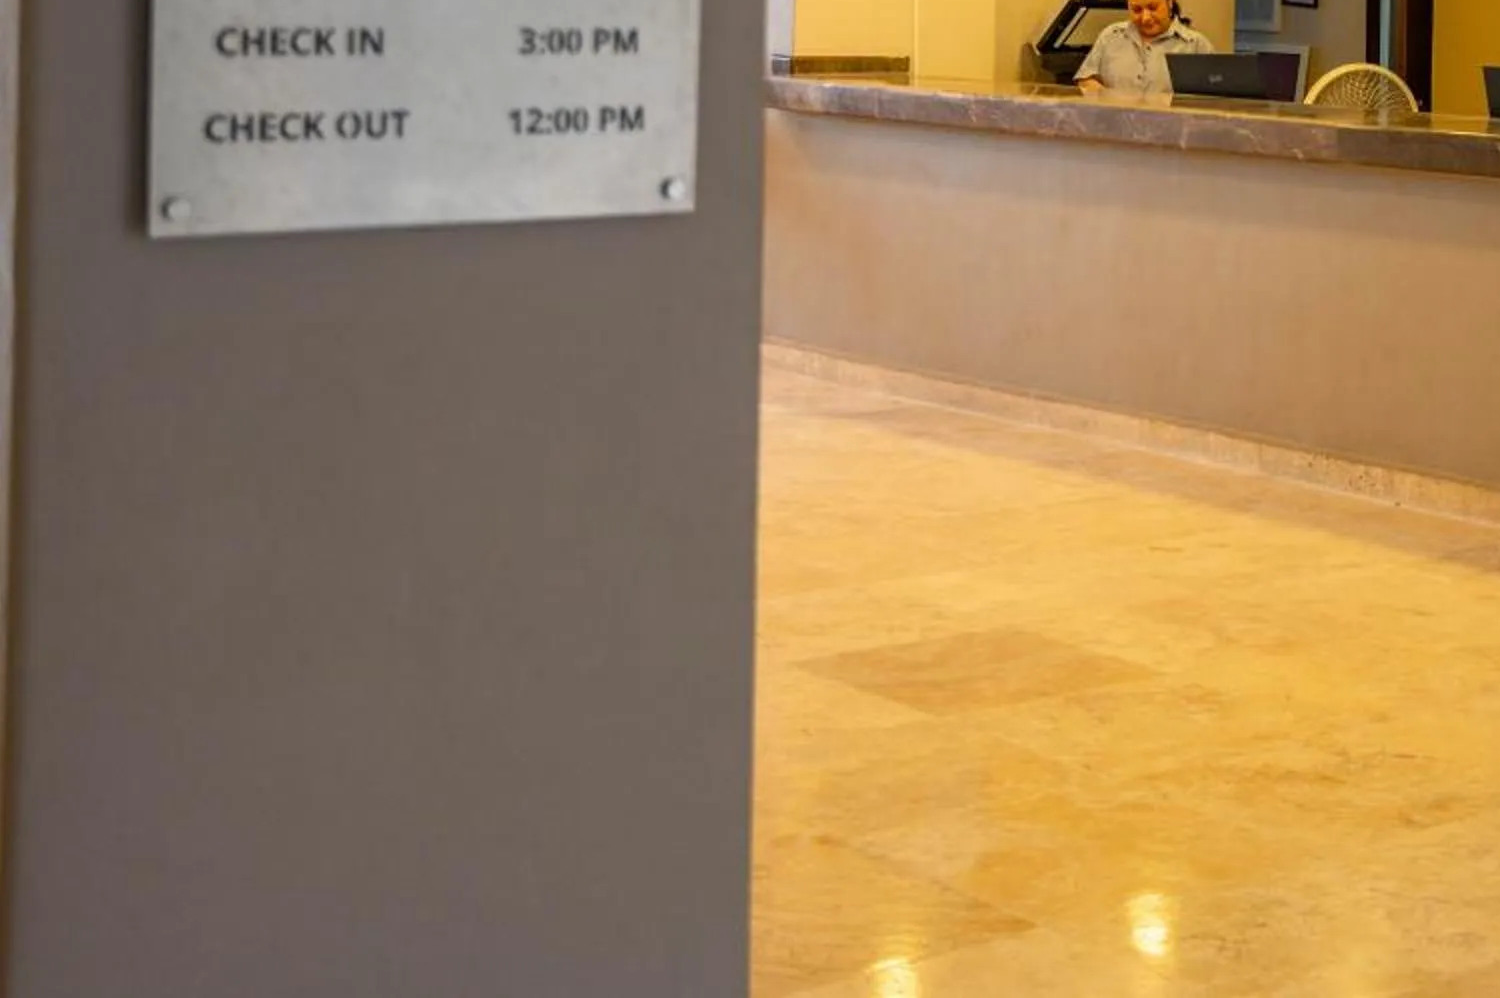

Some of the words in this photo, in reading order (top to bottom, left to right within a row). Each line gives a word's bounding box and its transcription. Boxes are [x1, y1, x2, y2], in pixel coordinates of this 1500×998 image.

[214, 26, 335, 58] CHECK
[346, 27, 385, 56] IN
[518, 26, 584, 56] 3:00
[592, 27, 639, 54] PM
[201, 112, 324, 145] CHECK
[334, 108, 410, 140] OUT
[507, 106, 590, 136] 12:00
[598, 105, 645, 132] PM
